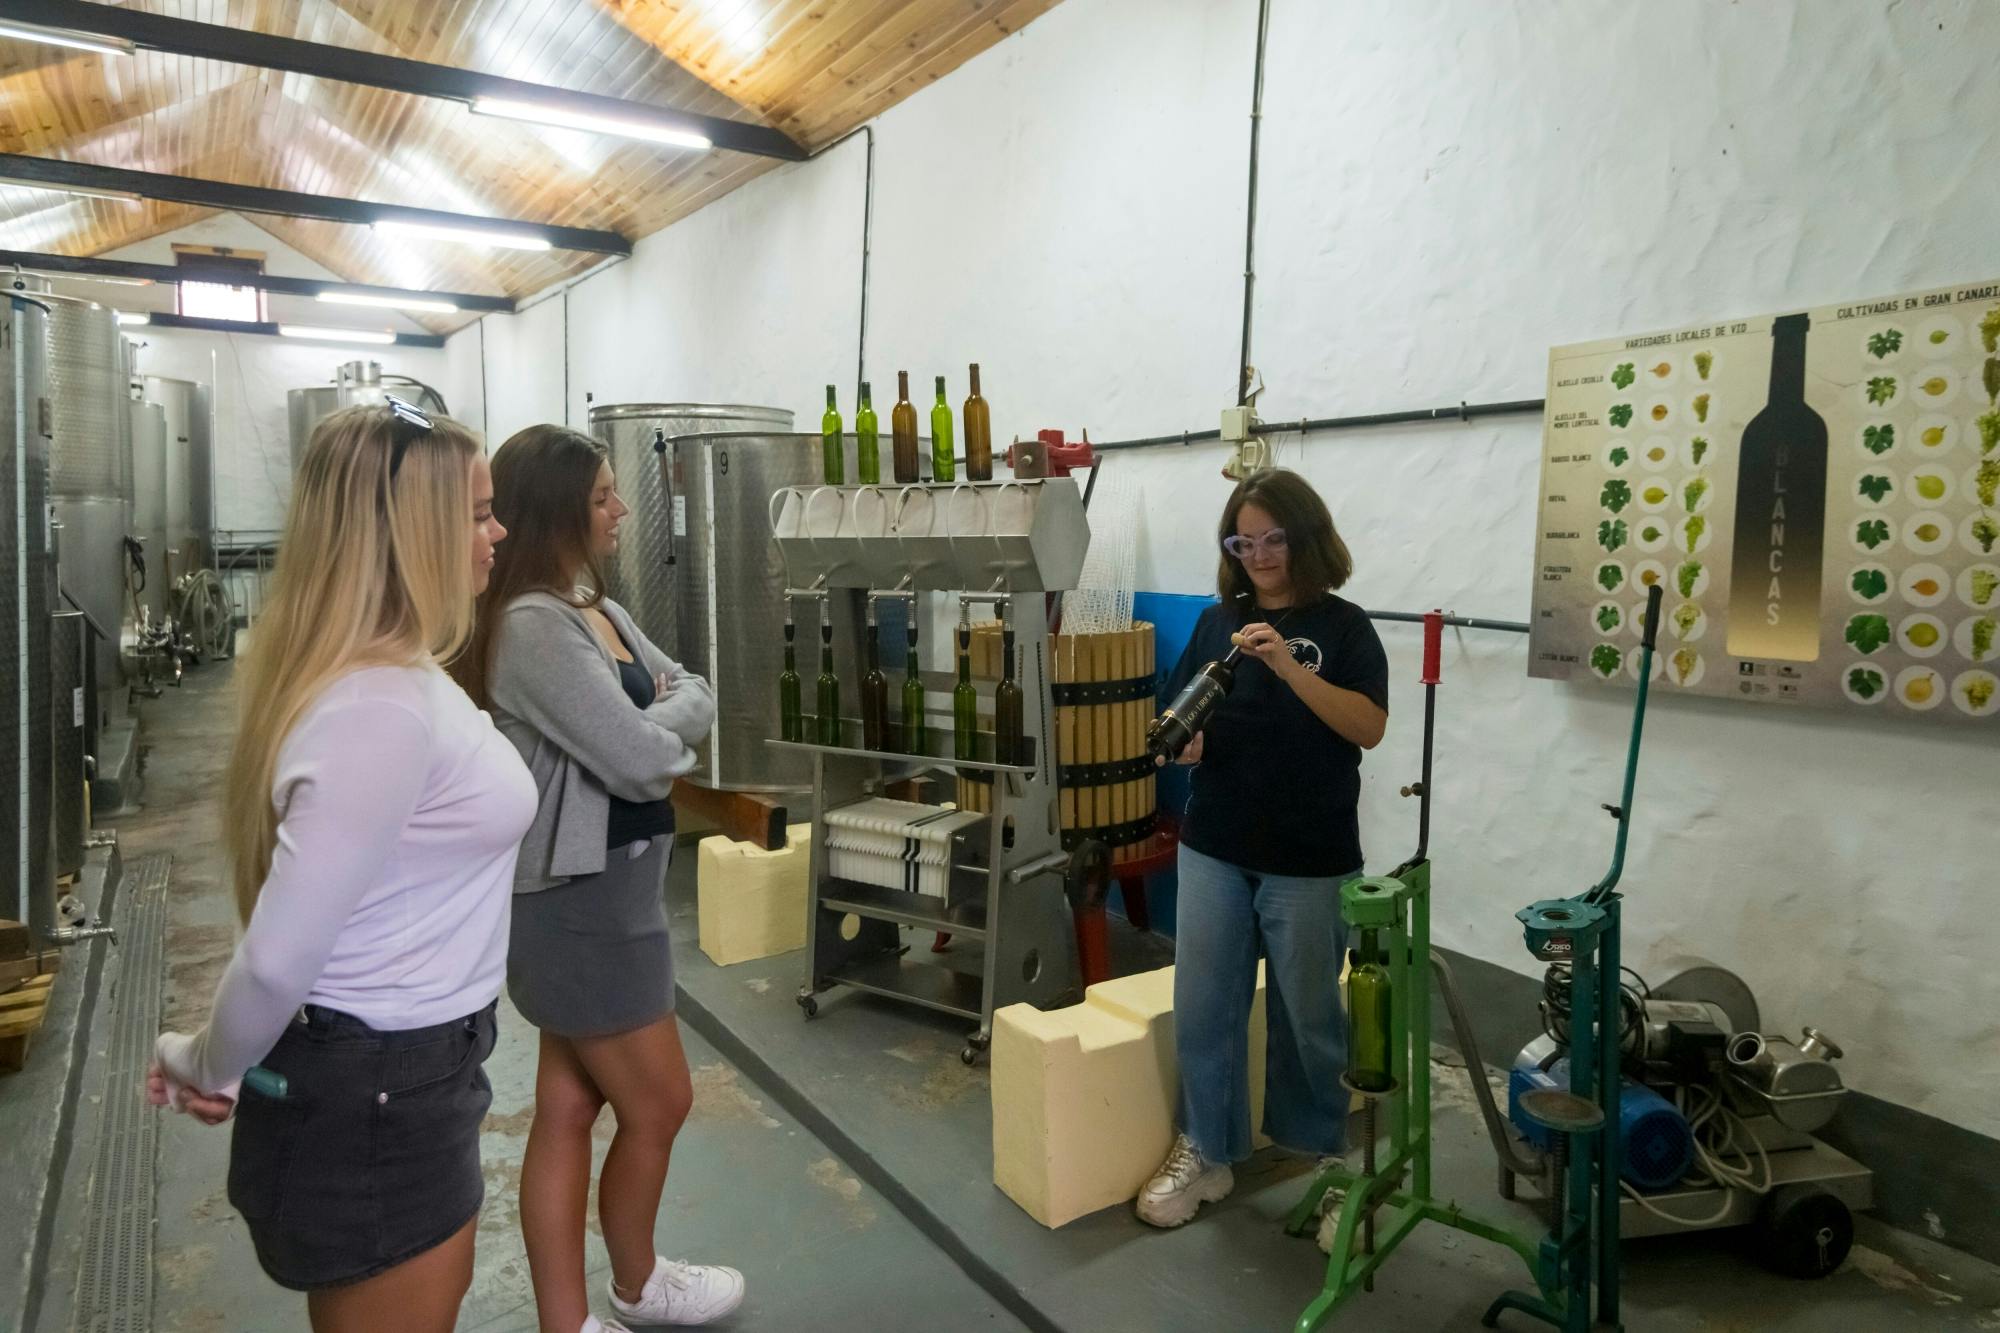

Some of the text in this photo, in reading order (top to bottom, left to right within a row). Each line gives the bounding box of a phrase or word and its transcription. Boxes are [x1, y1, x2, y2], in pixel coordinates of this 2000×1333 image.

[1837, 286, 2000, 319] CULTIVADAS EN GRAN CANARI
[1625, 323, 1747, 349] VARIEDADES LOCALES DE VID
[720, 451, 729, 476] 9
[1766, 445, 1789, 626] BLANCAS
